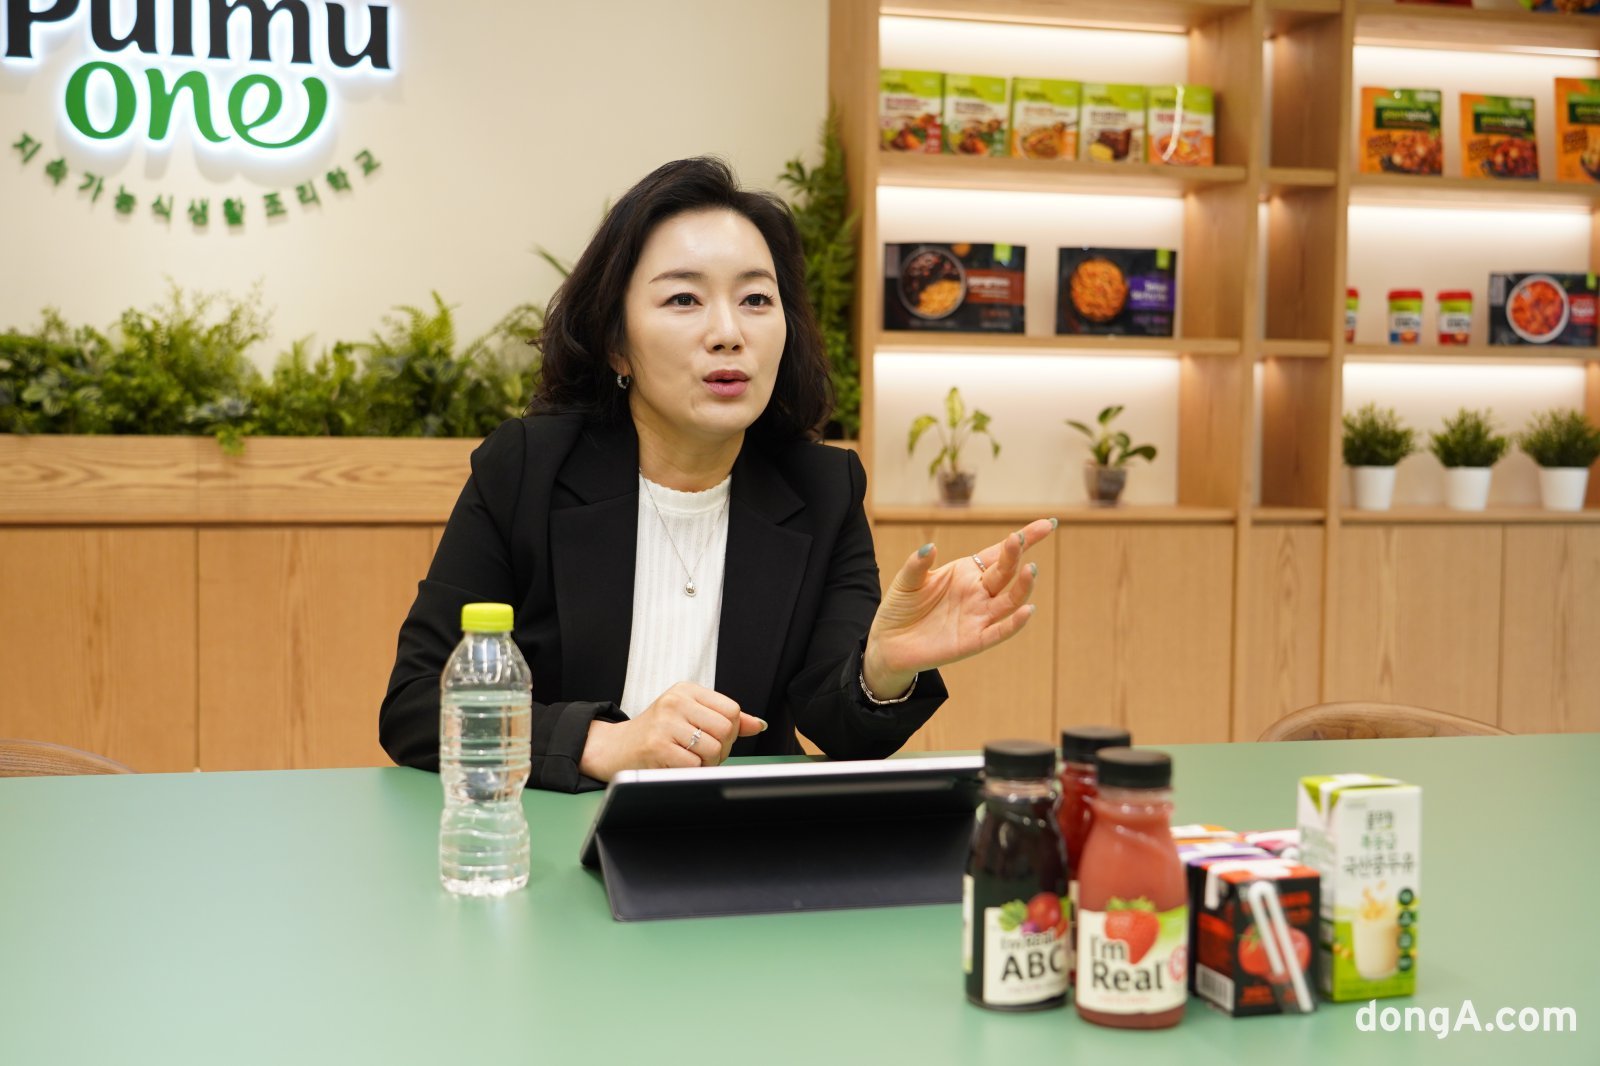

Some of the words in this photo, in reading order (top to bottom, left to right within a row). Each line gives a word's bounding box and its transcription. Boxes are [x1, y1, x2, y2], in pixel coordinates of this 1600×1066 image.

[5, 0, 392, 70] Pulmu
[65, 61, 328, 149] one
[1001, 943, 1063, 981] ABC
[1090, 936, 1126, 960] I'm
[1091, 961, 1163, 991] Real
